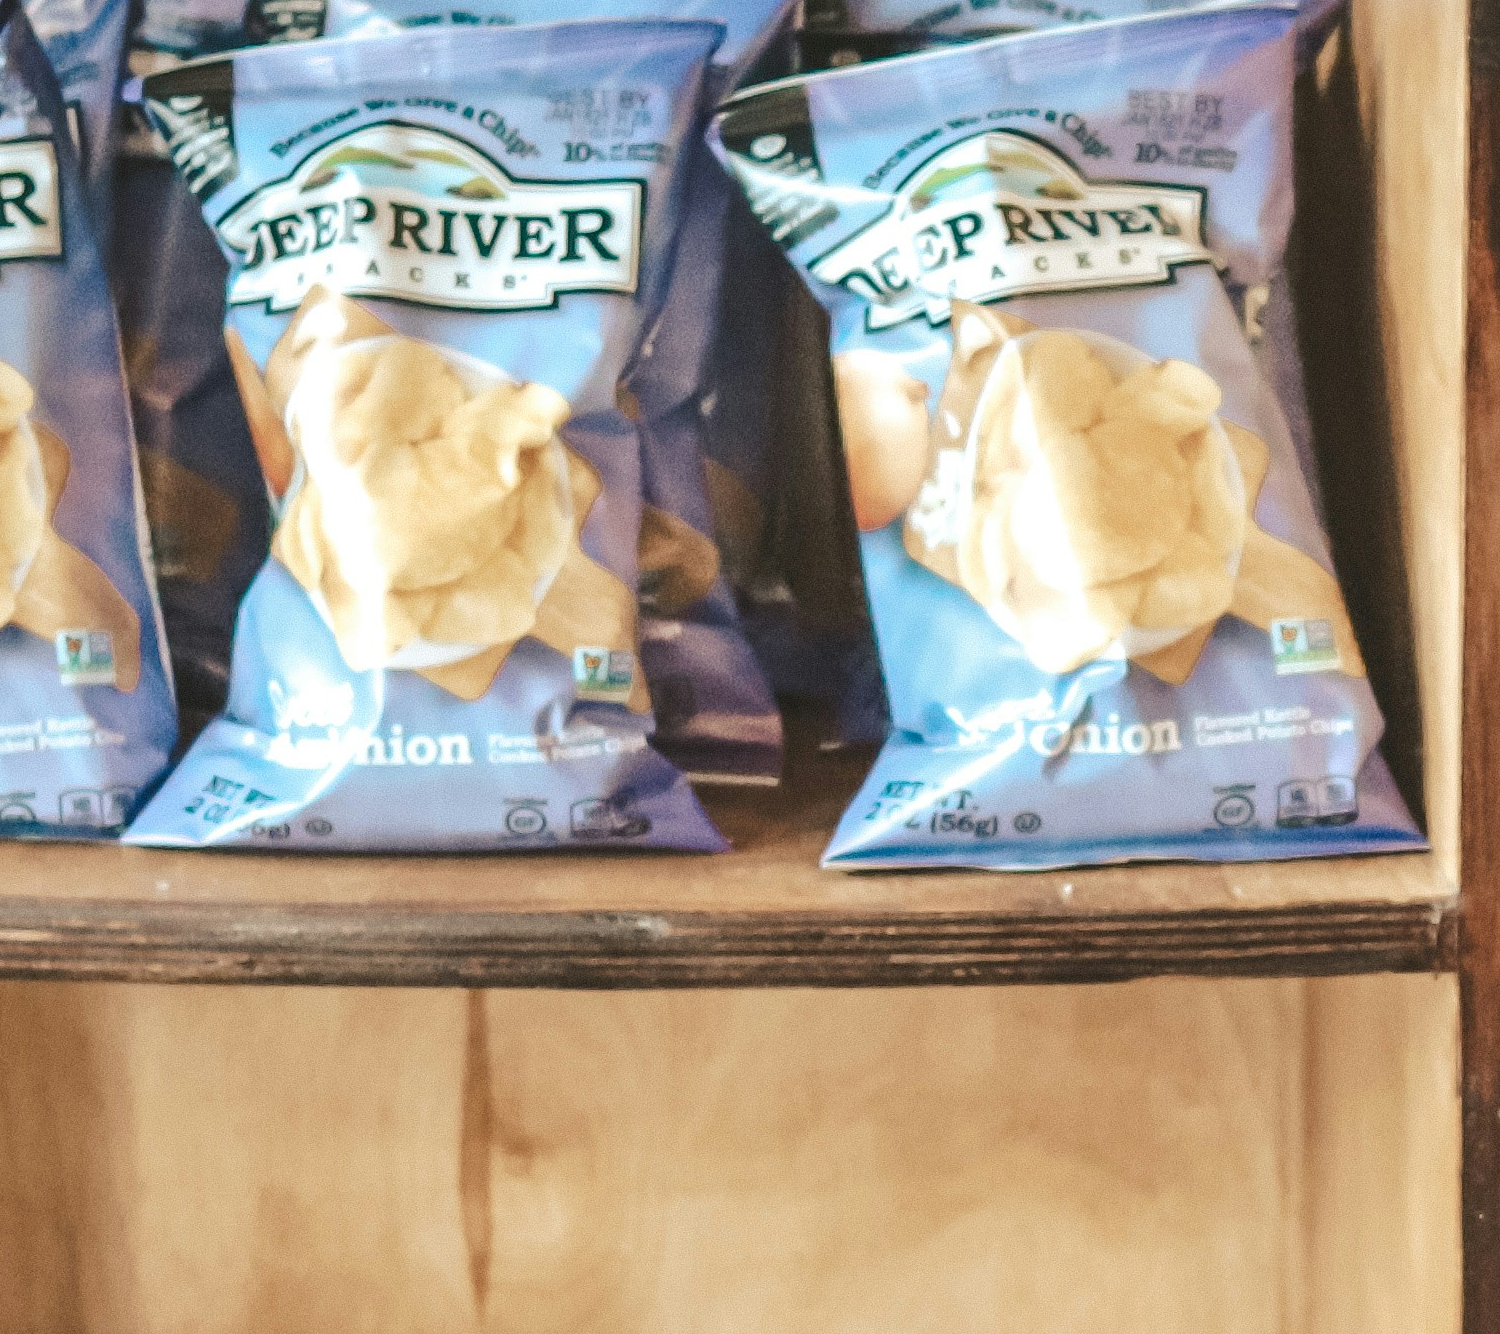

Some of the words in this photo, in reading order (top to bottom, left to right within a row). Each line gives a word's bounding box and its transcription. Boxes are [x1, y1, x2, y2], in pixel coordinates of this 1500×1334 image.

[388, 200, 620, 264] RIVER
[342, 723, 474, 766] nion
[930, 813, 999, 838] (56g)
